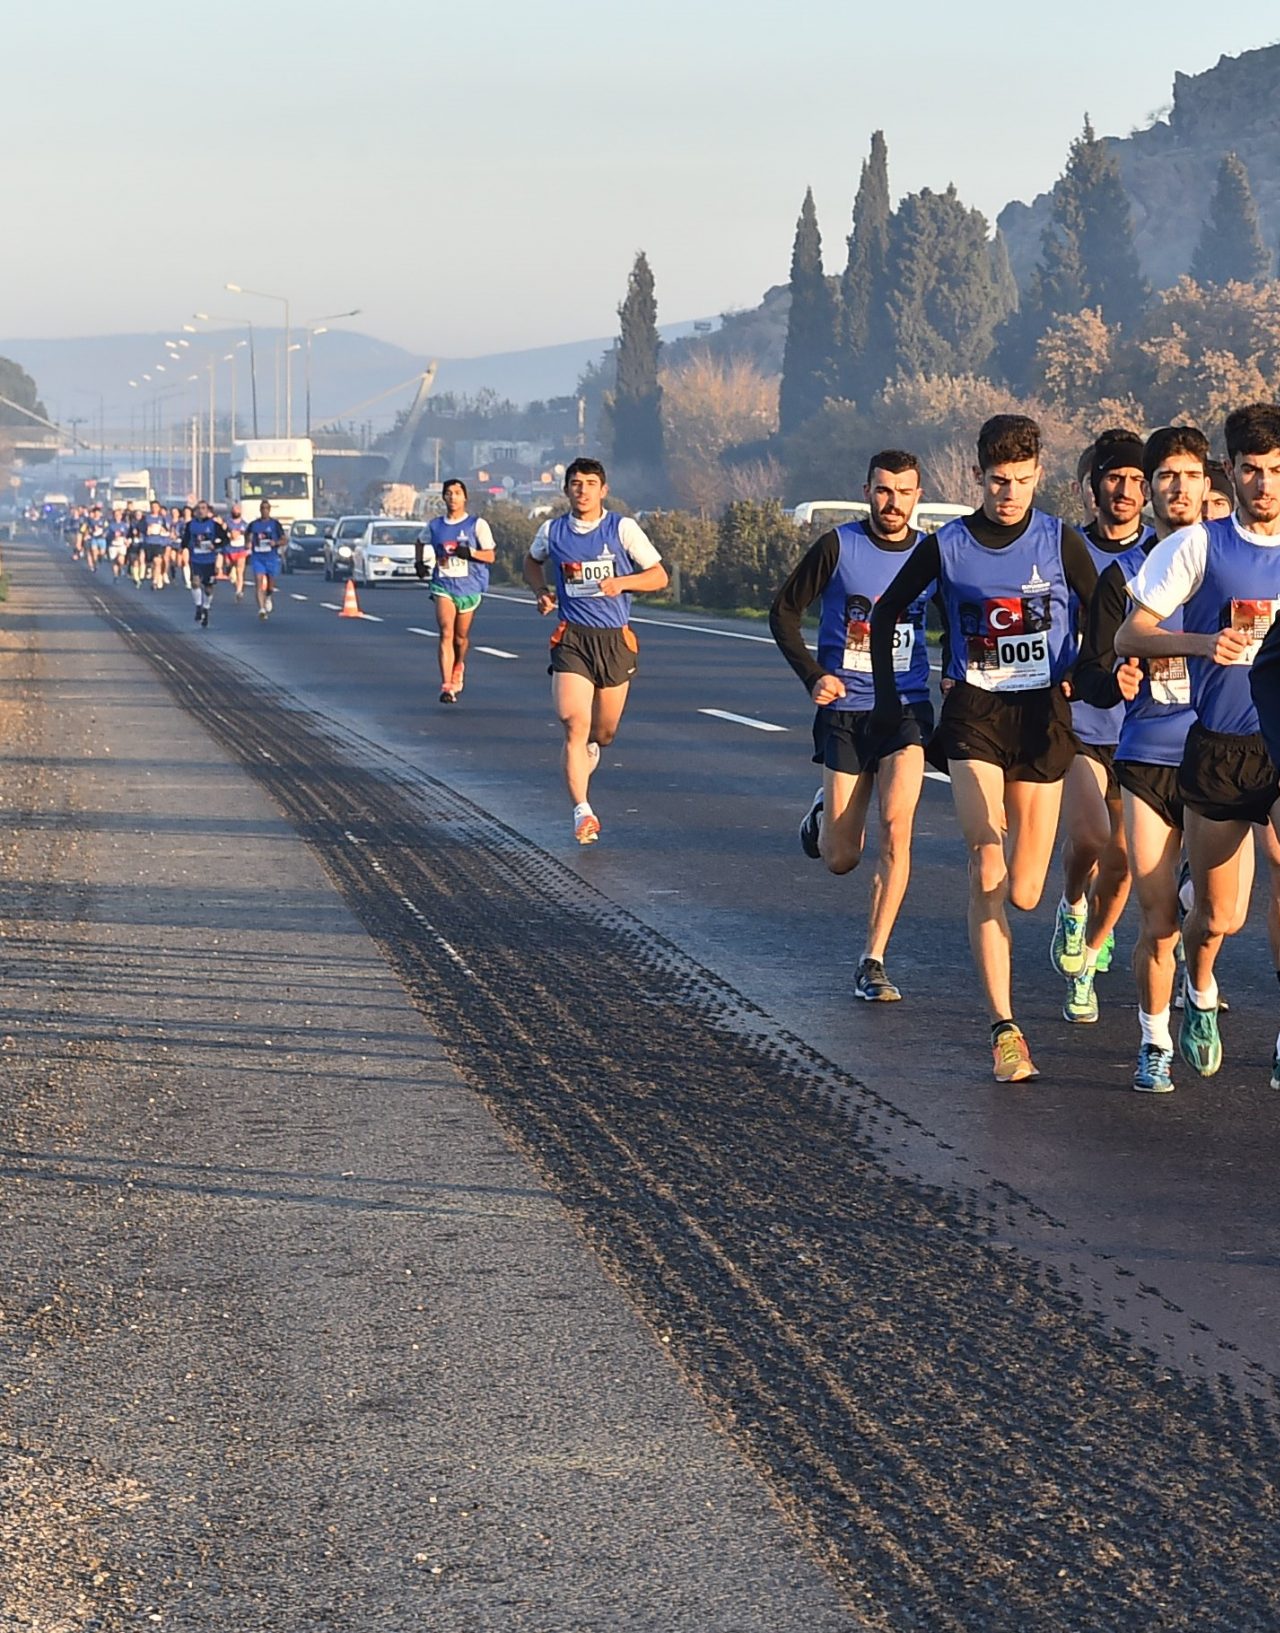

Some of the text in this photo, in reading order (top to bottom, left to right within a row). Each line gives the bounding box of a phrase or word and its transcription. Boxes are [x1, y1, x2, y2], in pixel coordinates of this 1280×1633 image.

[585, 566, 610, 580] 003
[892, 629, 910, 648] 81
[1001, 640, 1045, 664] 005
